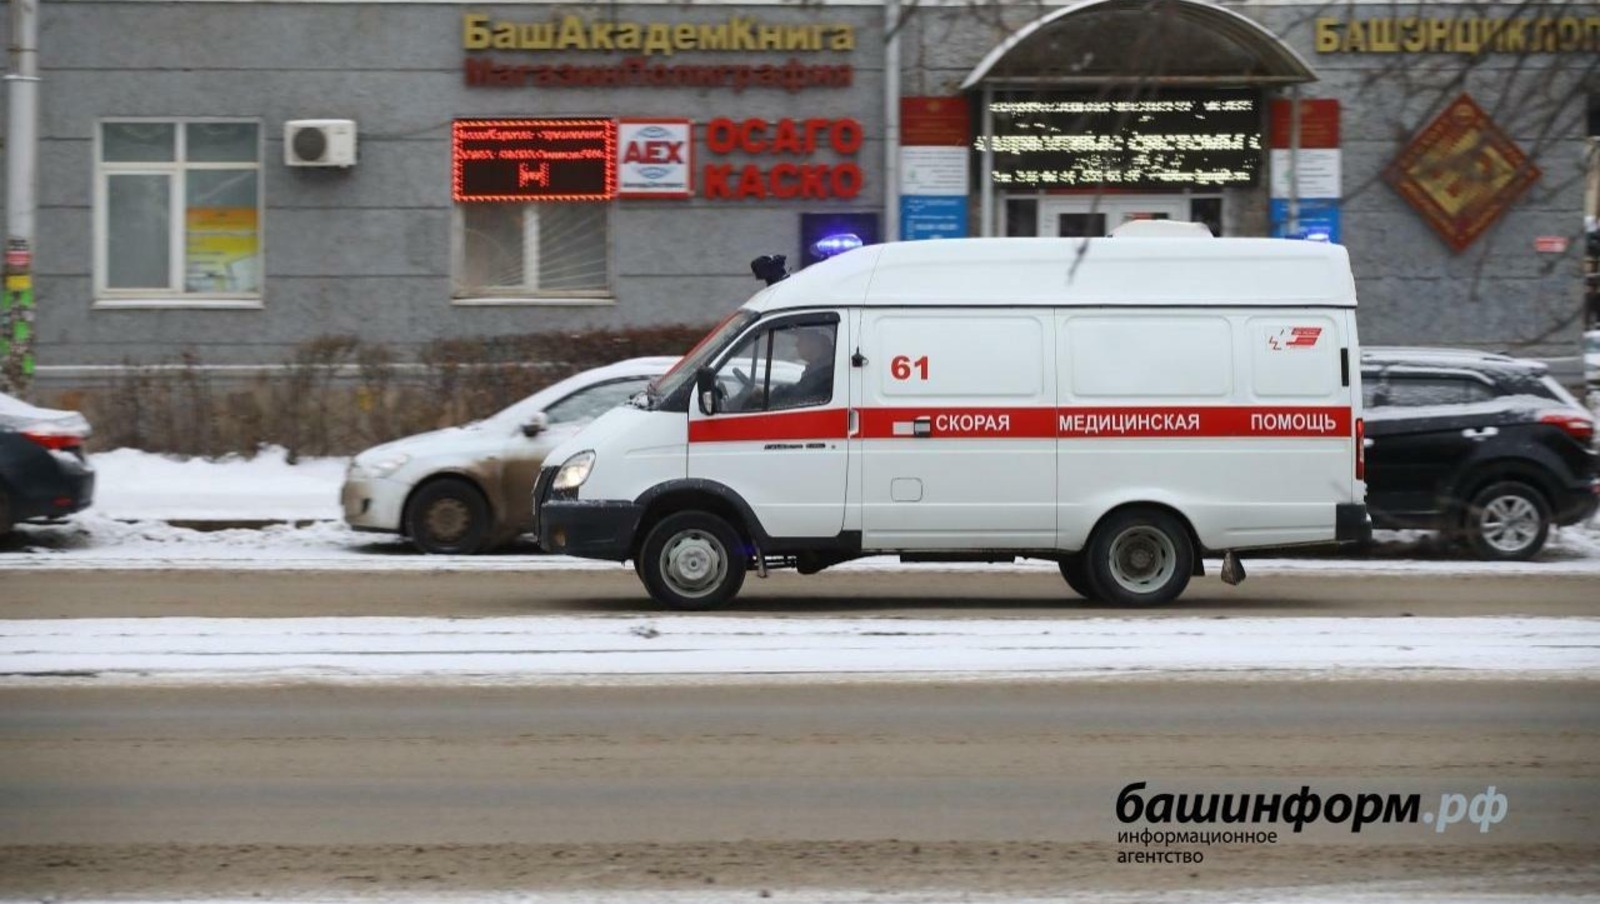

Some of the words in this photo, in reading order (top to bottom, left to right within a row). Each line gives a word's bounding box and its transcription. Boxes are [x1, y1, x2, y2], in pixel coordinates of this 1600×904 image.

[463, 13, 854, 55] БашАкадемКнига
[706, 117, 863, 154] ОСАГО
[704, 163, 863, 200] КАСКО
[890, 355, 929, 381] 61
[936, 414, 1010, 431] СКОРАЯ
[1059, 414, 1200, 433] МЕДИЦИНСКАЯ
[1251, 413, 1337, 432] ПОМОЩЬ
